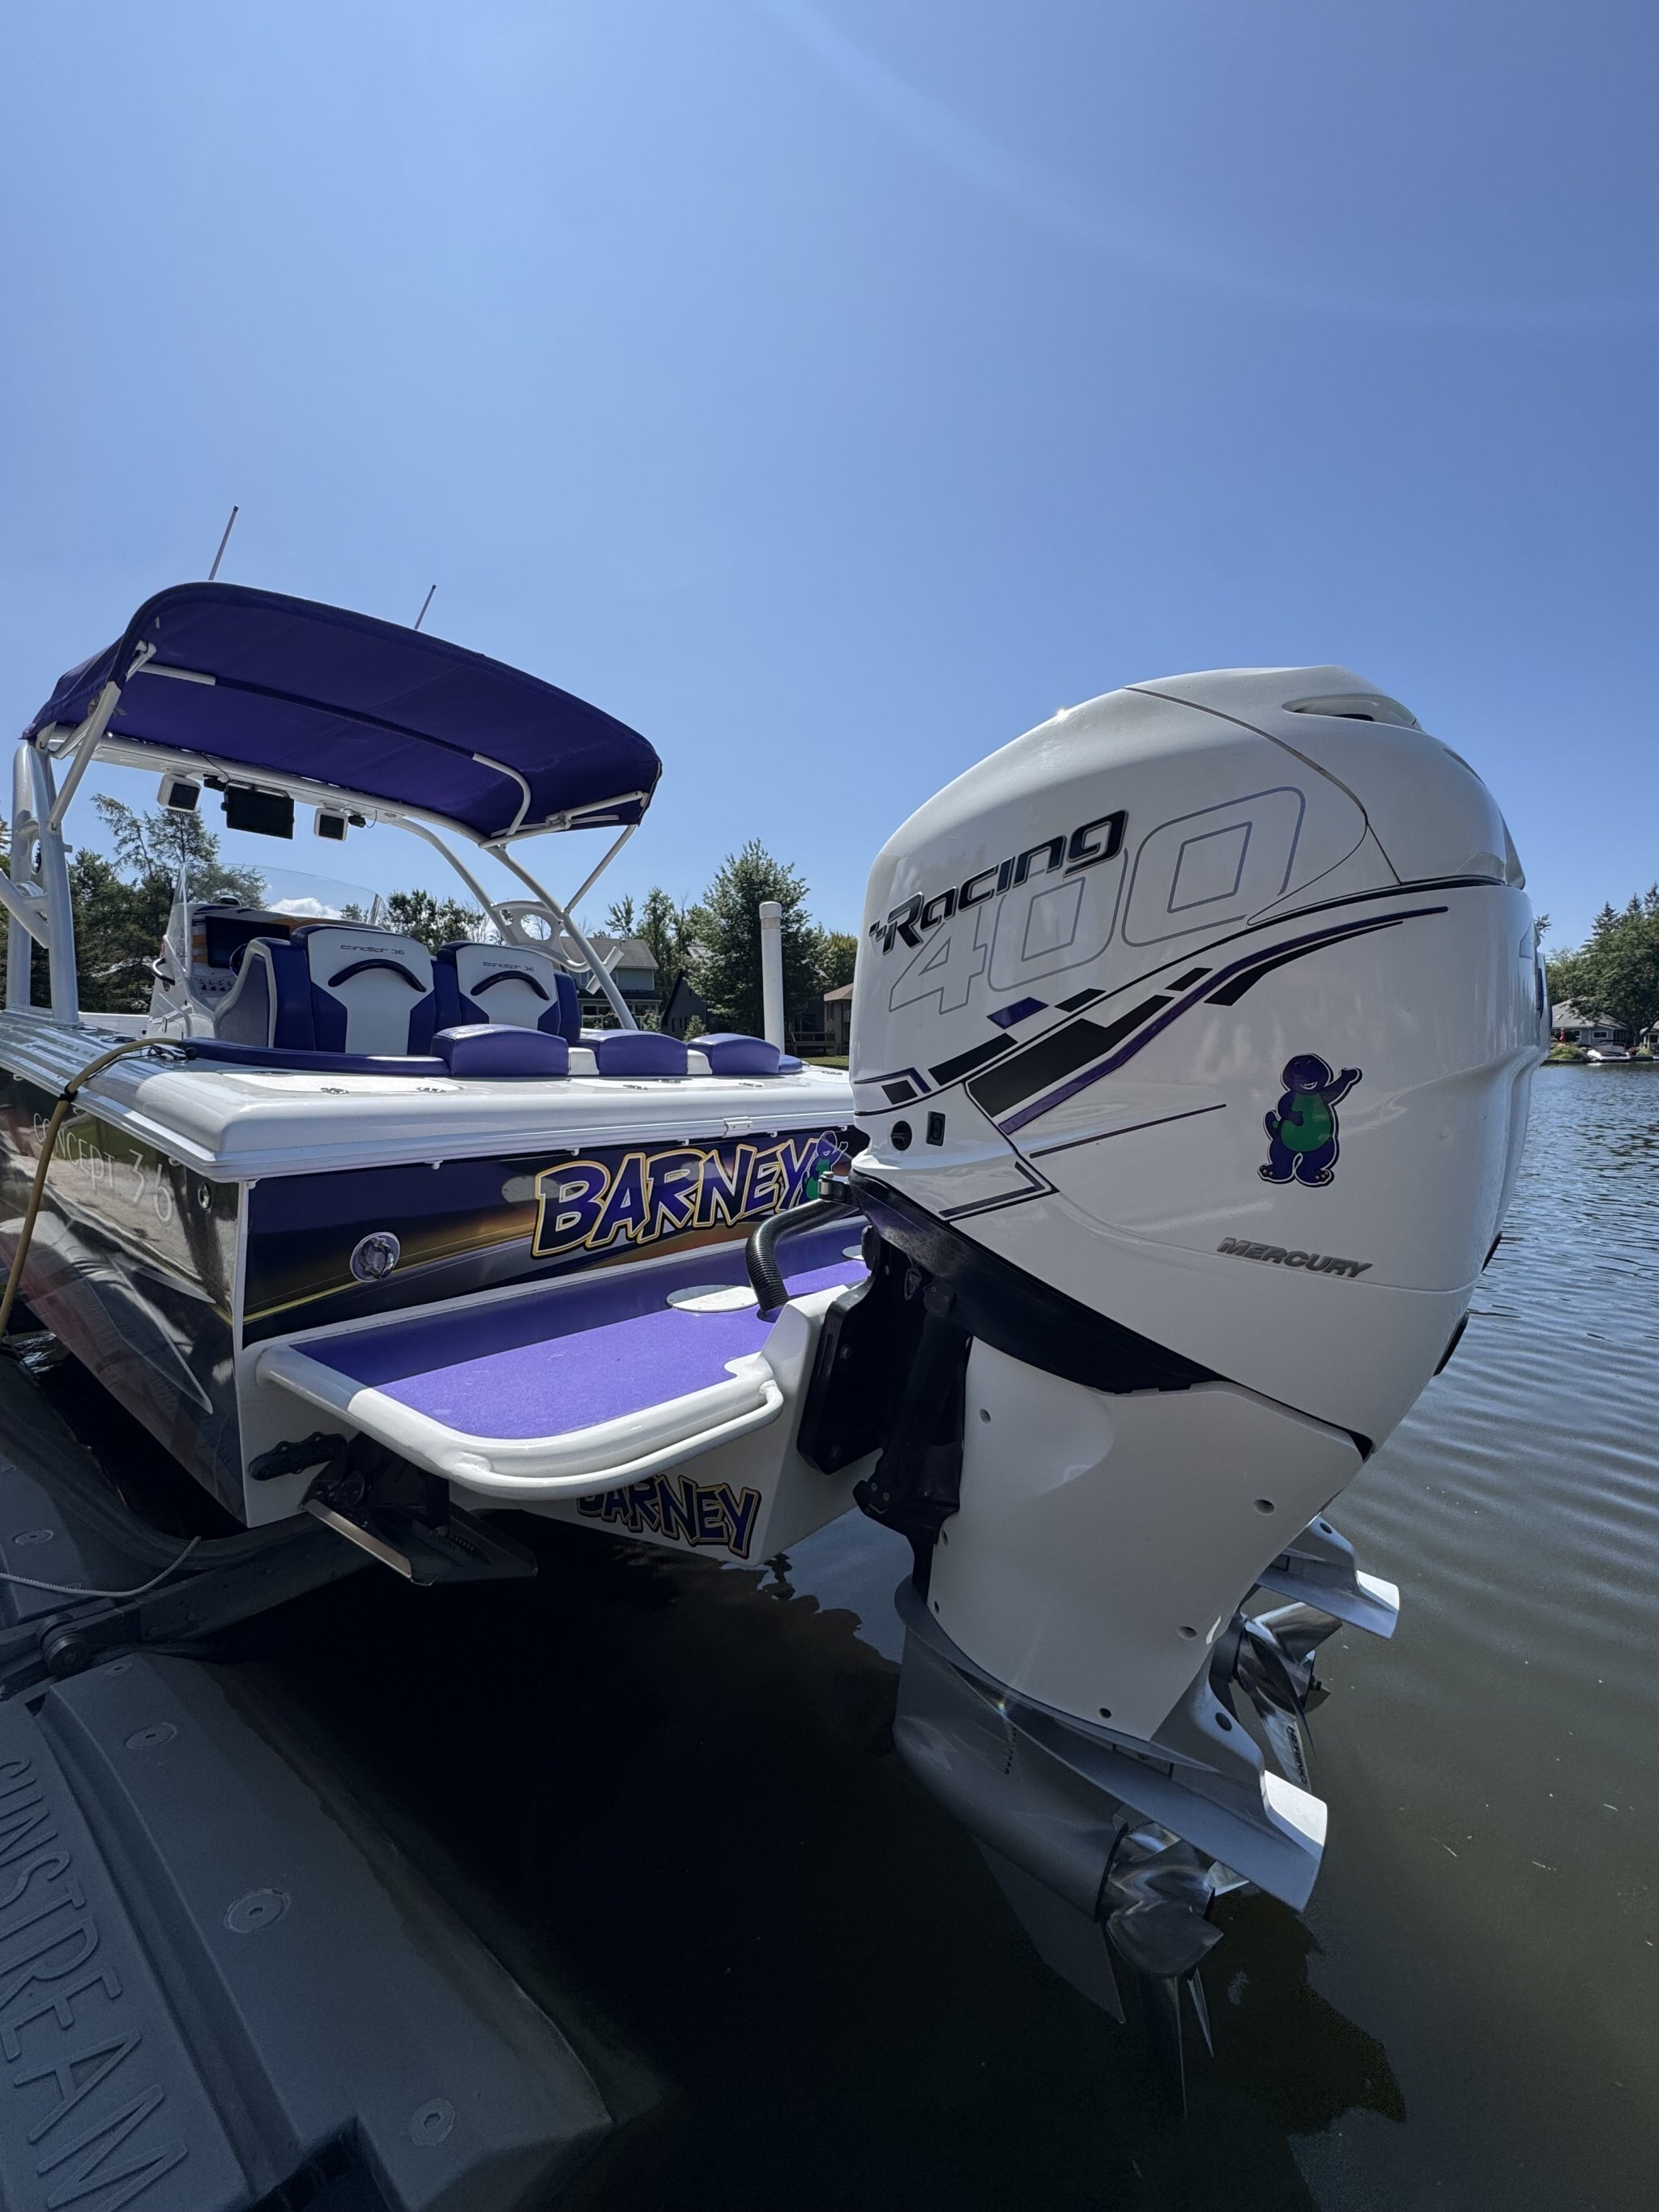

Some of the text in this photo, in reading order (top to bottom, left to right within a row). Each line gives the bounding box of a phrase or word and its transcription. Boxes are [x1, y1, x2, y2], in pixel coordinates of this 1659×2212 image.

[876, 808, 1130, 957] Racing
[889, 786, 1306, 1016] 400
[129, 1148, 173, 1222] 36
[531, 1137, 819, 1258] BARNEY
[1216, 1236, 1374, 1278] MERCURY
